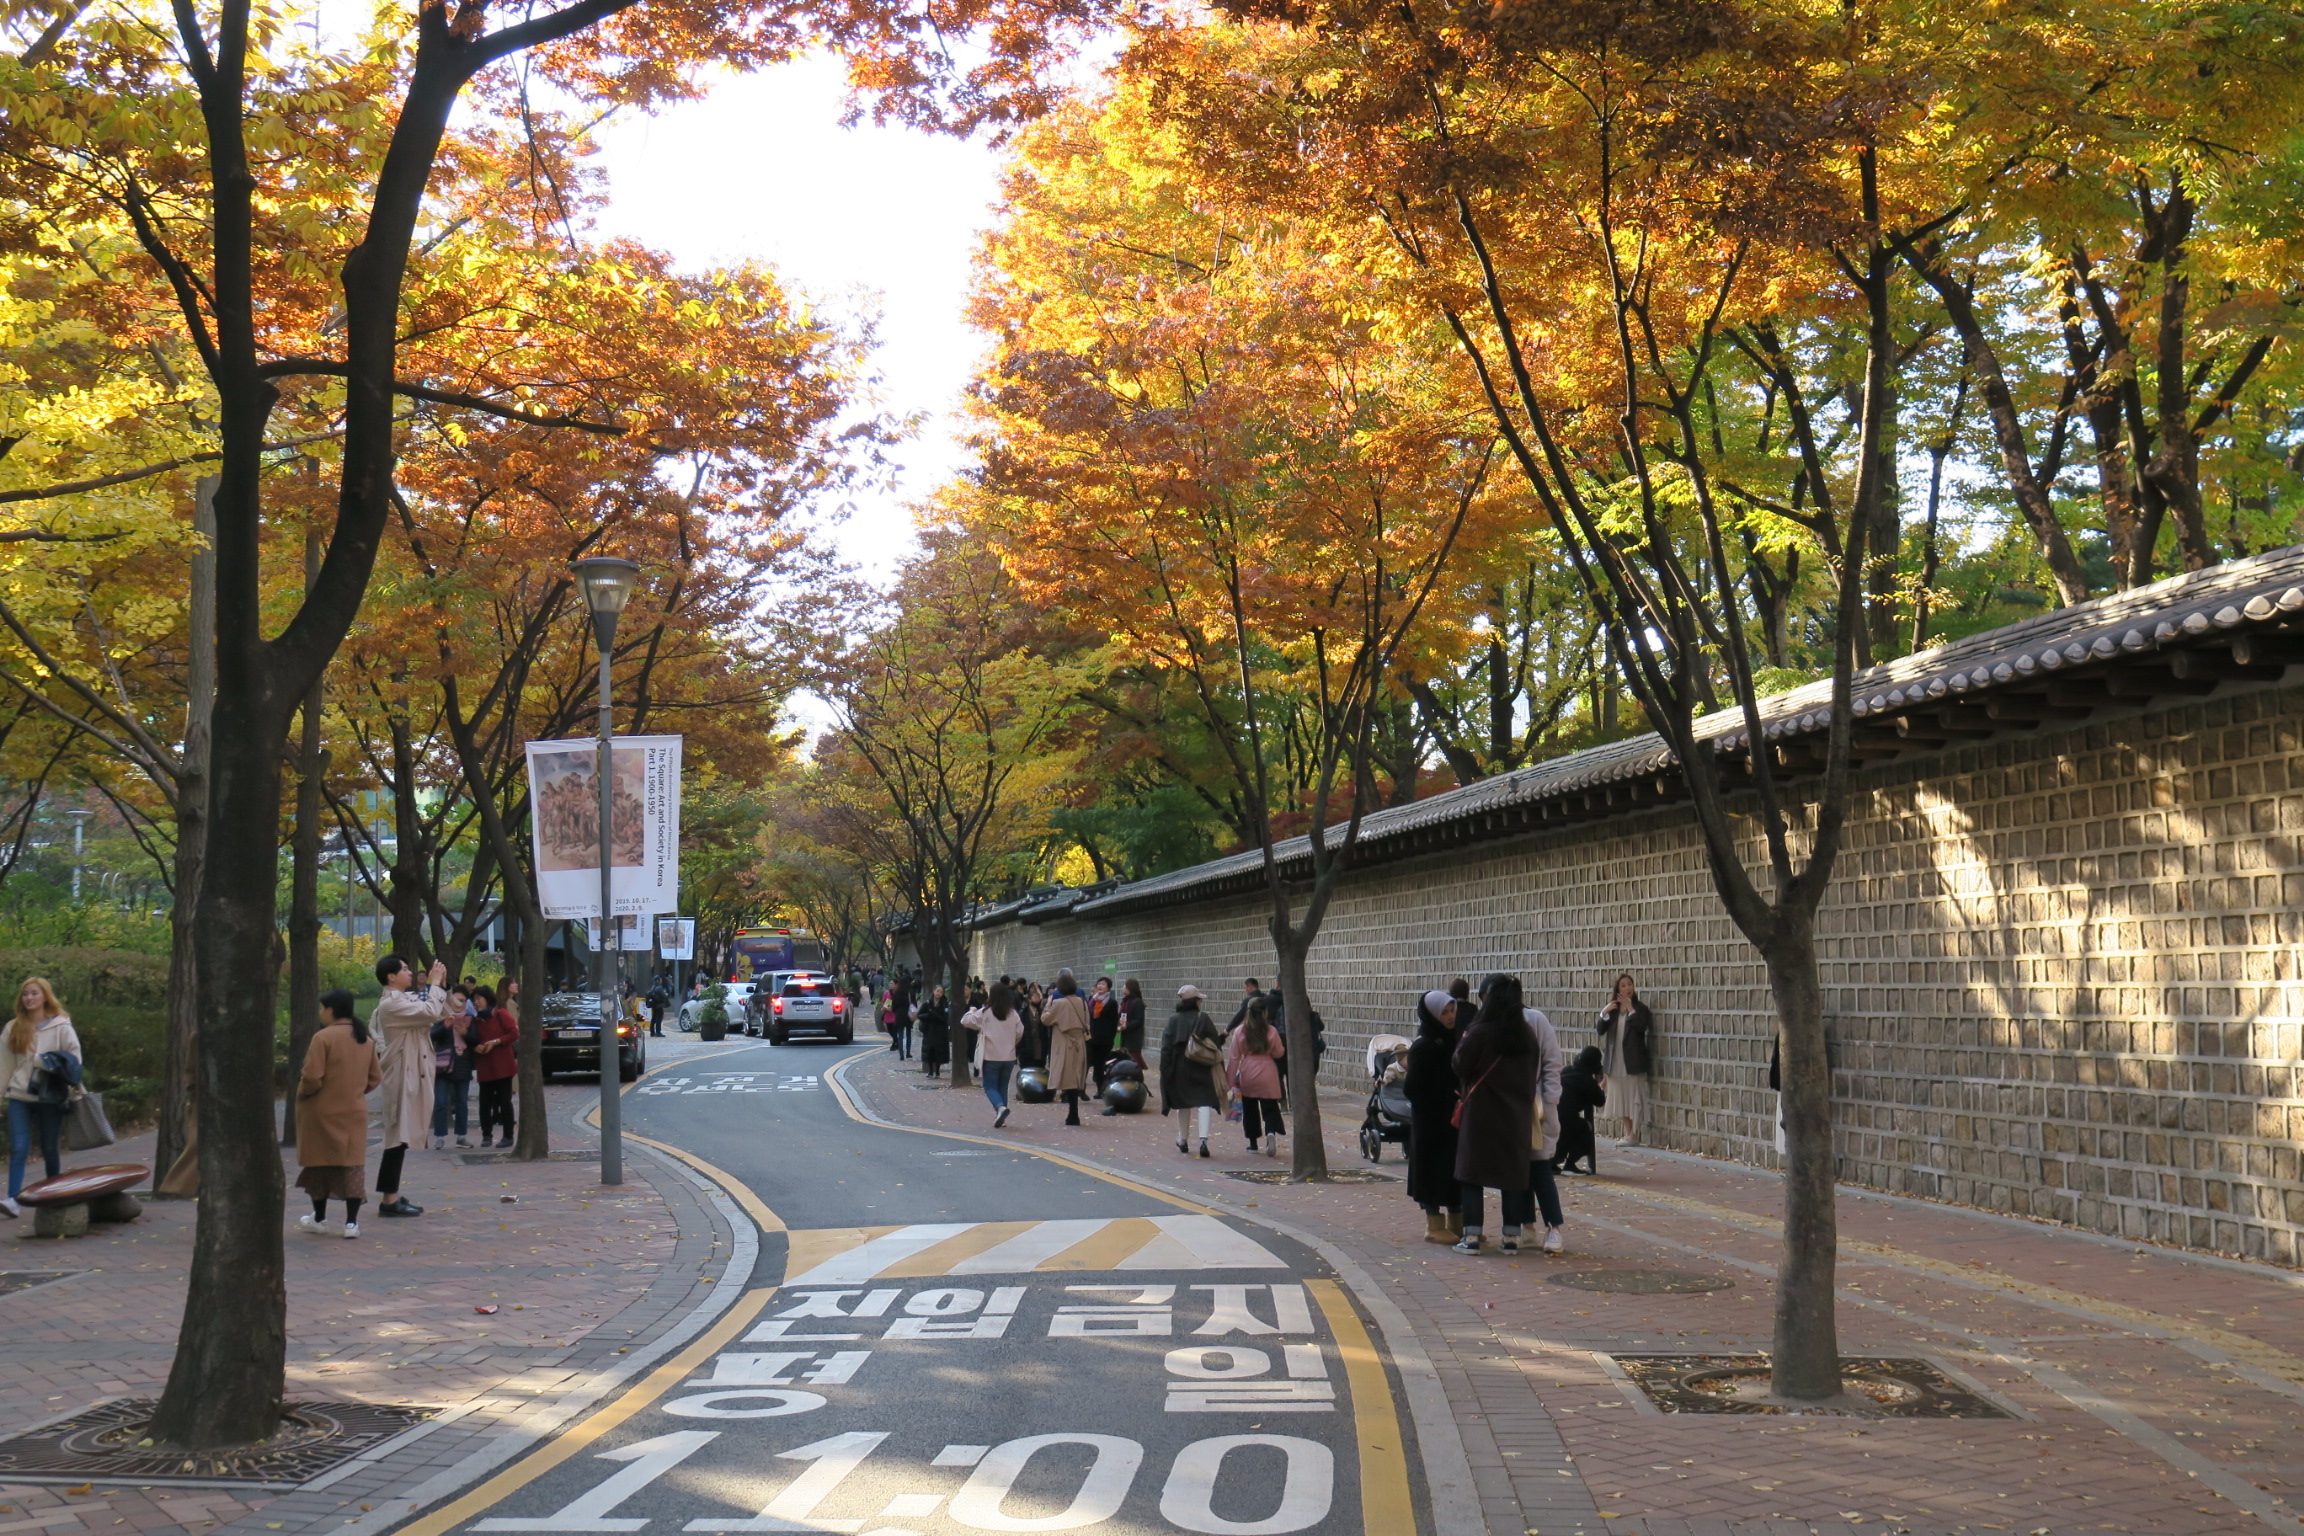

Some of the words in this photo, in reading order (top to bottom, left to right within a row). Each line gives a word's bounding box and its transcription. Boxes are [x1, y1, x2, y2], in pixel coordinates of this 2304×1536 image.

[648, 748, 656, 765] Part
[658, 748, 666, 762] The
[657, 764, 666, 793] Square:
[656, 824, 665, 854] Society
[465, 1430, 1334, 1535] 11:00
